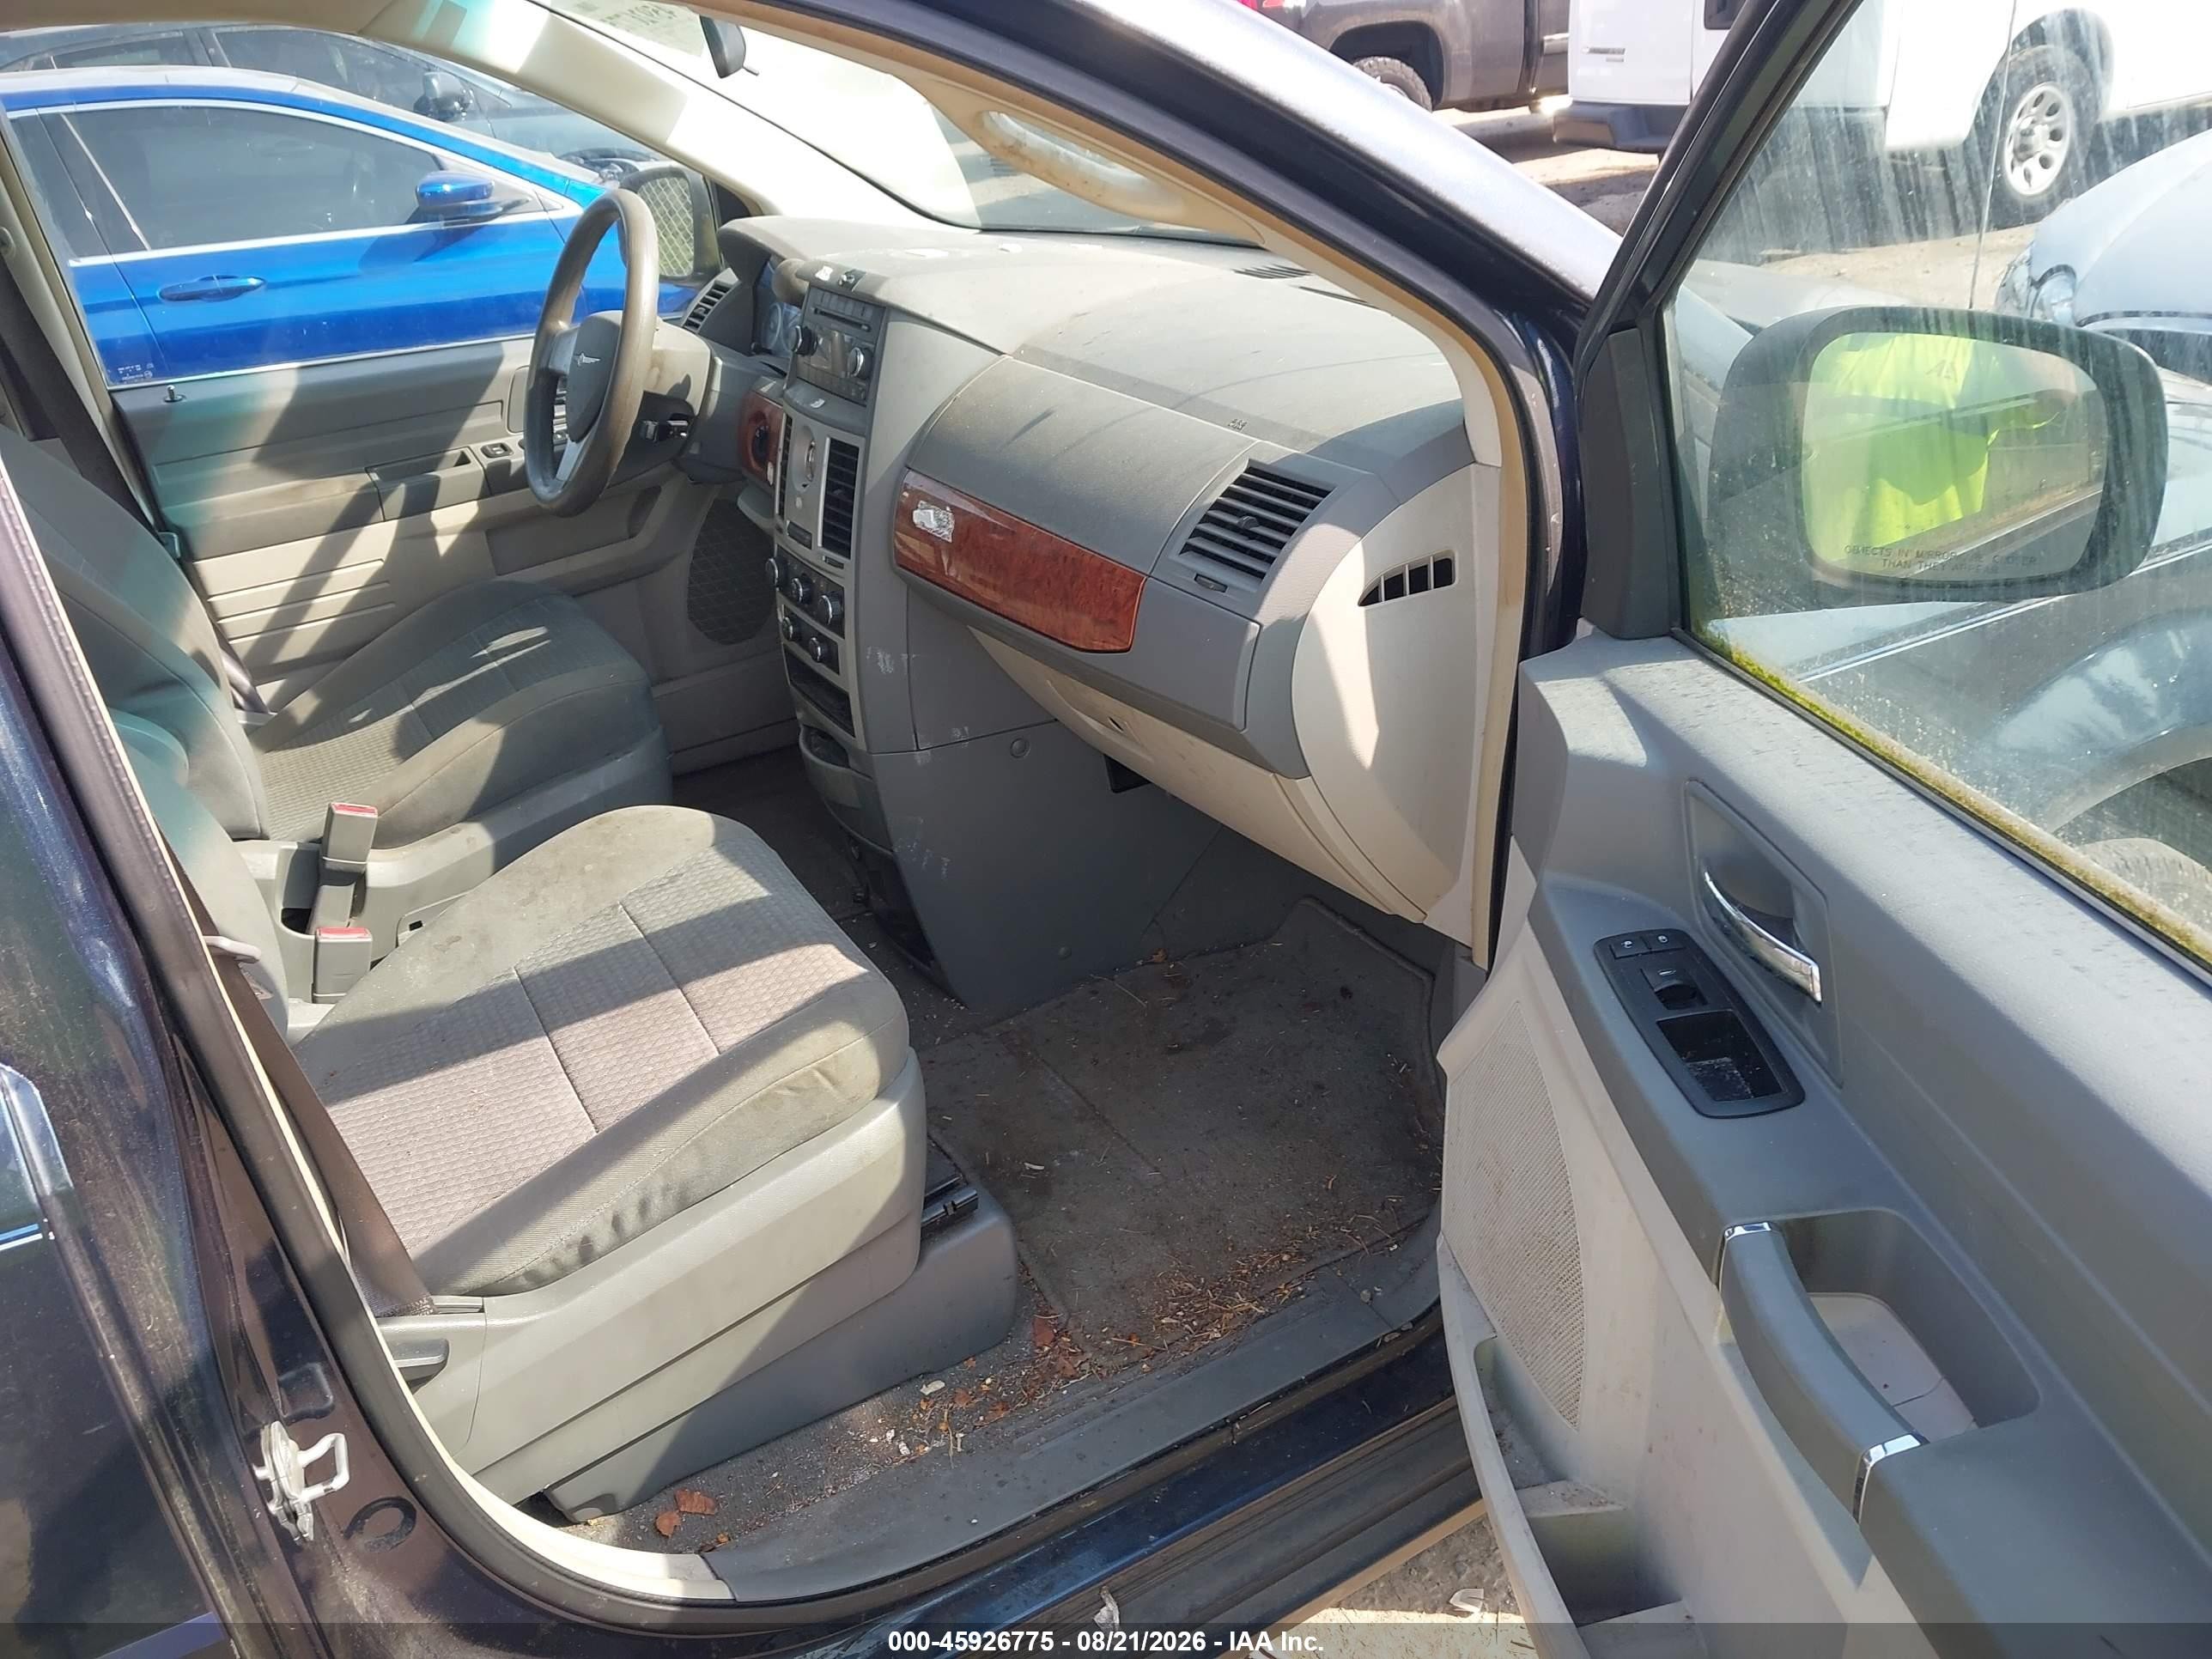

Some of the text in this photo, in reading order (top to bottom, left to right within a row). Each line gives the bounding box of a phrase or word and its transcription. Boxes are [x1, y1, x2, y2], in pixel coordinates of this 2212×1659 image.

[1844, 544, 1892, 557] OBJECTS
[1897, 549, 1909, 557] IN
[1992, 555, 2038, 565] COER
[1882, 558, 1911, 569] THAN
[1918, 560, 1946, 571] THEY
